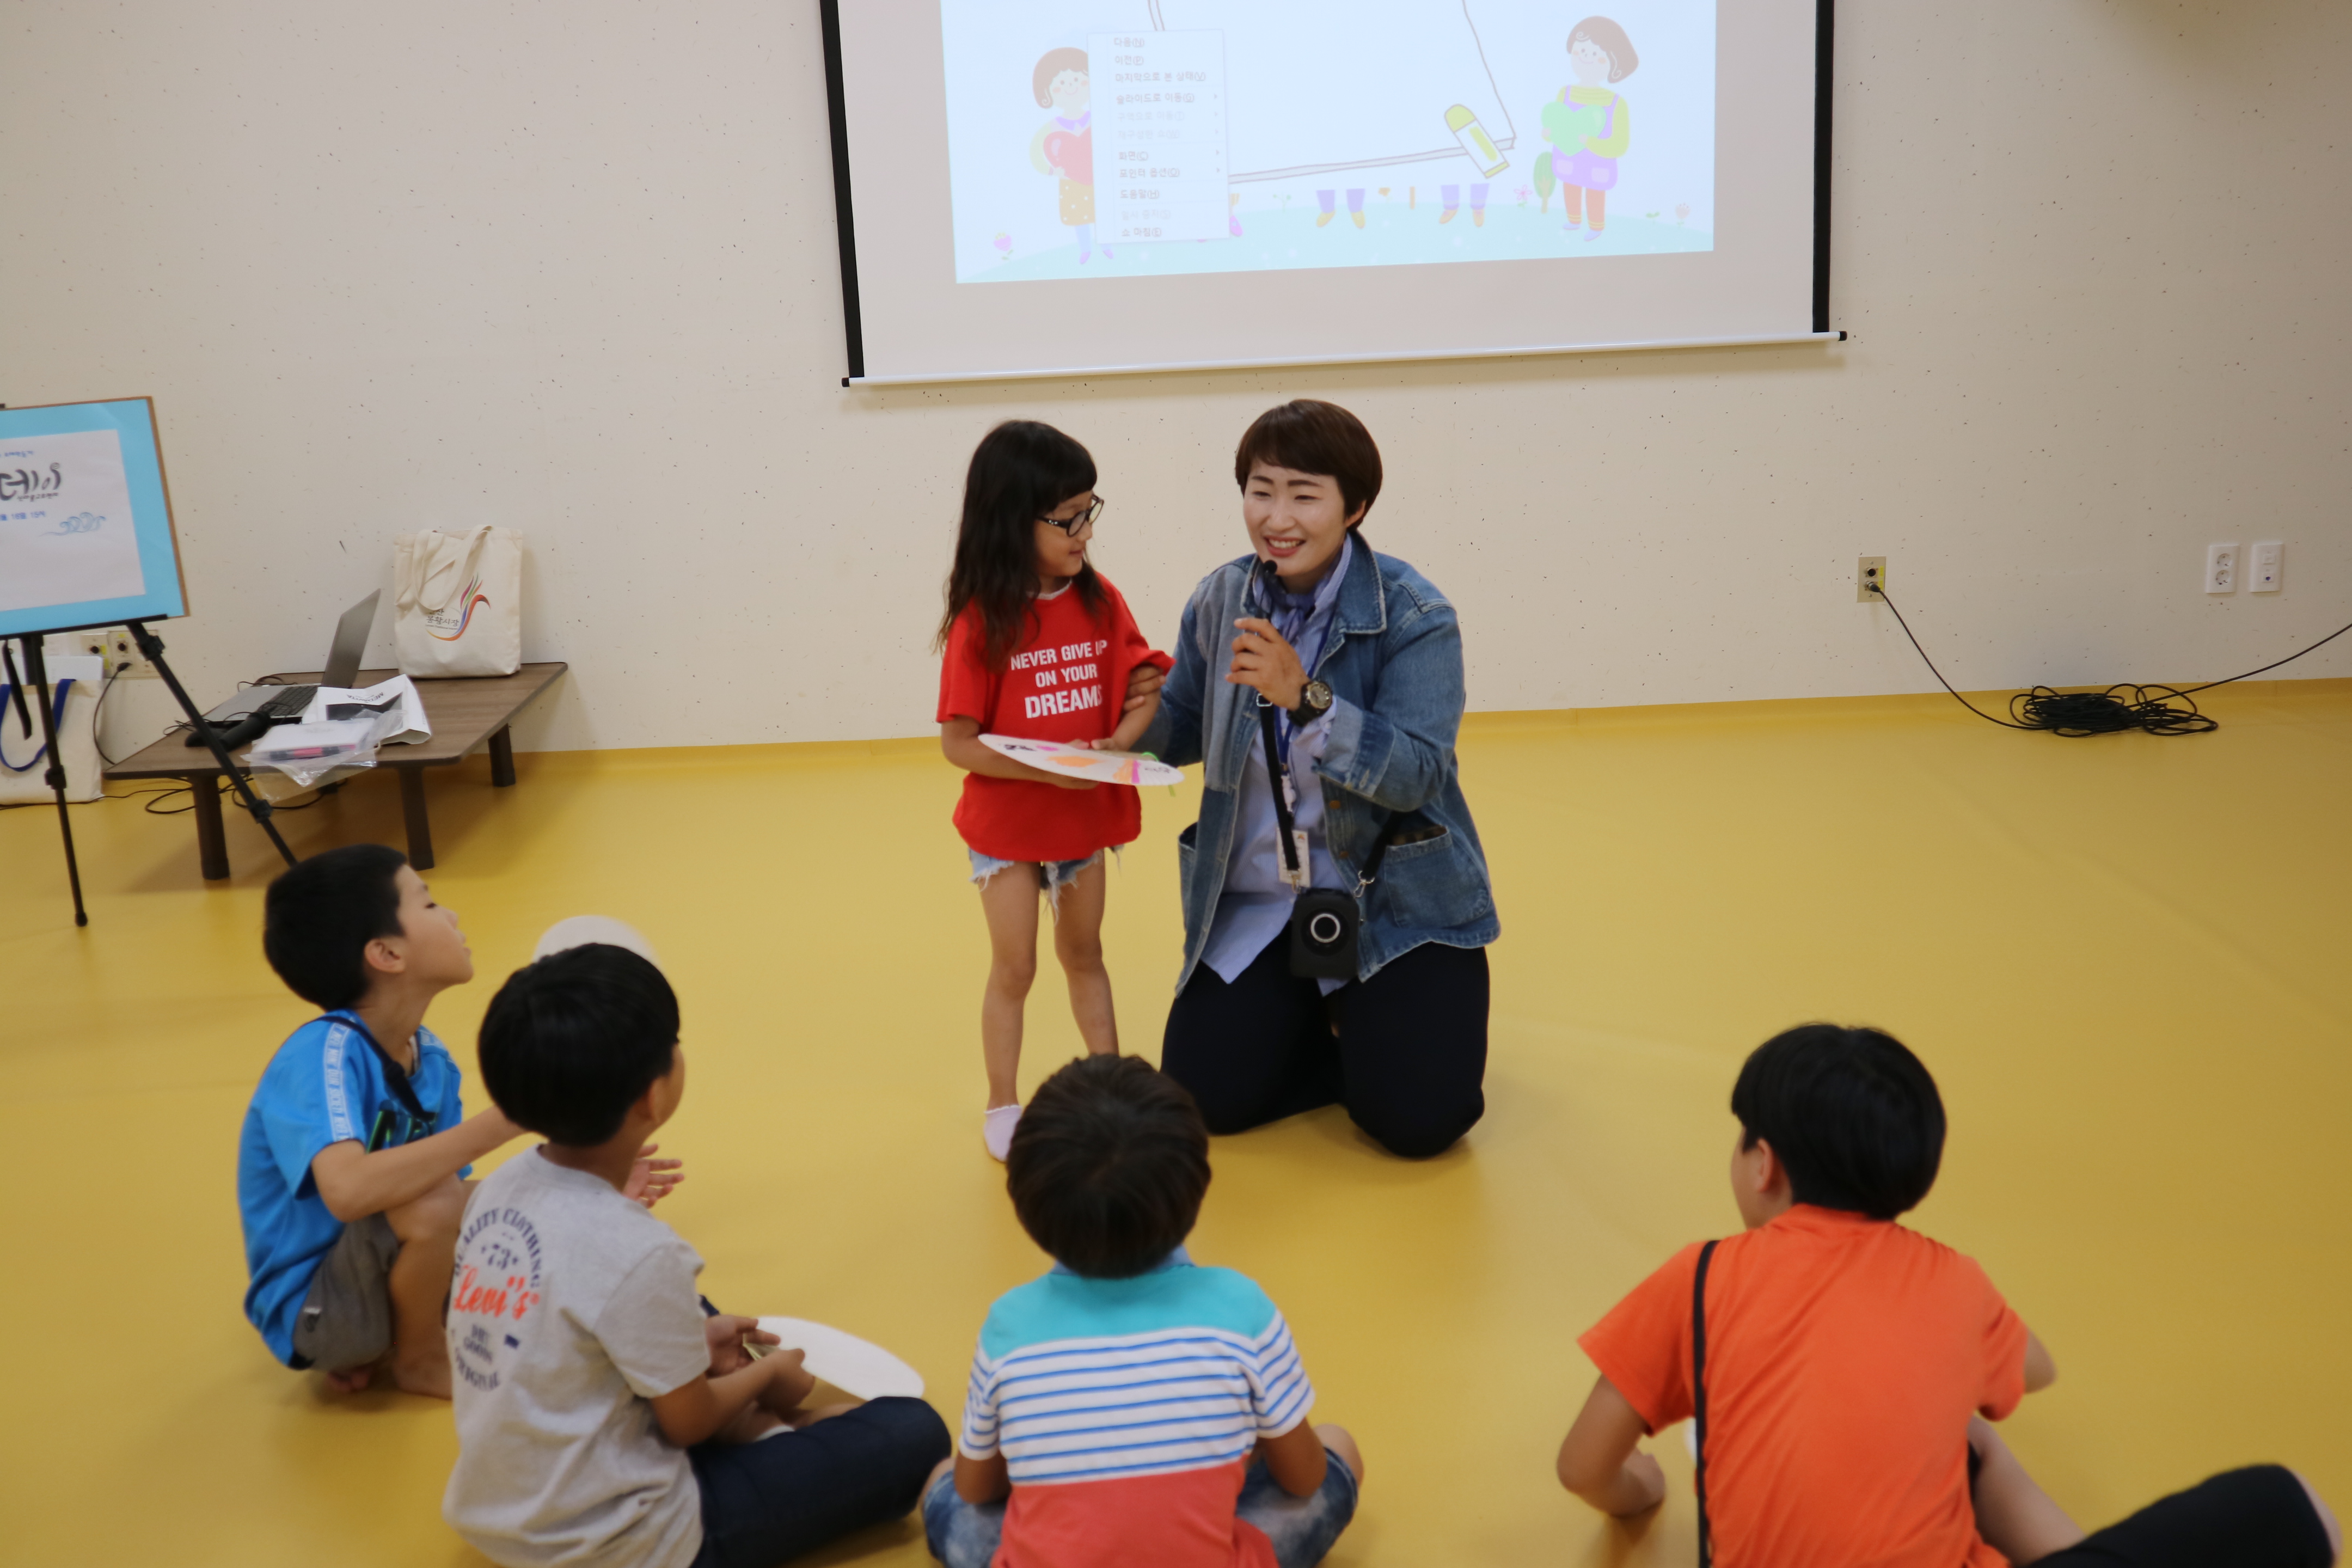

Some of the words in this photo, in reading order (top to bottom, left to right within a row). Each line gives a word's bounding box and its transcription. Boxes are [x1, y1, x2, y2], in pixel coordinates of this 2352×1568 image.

[1113, 37, 1145, 48] 다음(N)
[1114, 55, 1144, 66] 이전(P)
[1114, 72, 1160, 83] 마지막으로
[1118, 151, 1149, 161] 화면(C)
[1119, 168, 1146, 179] 포인터
[1120, 189, 1160, 200] 도움말(H)
[426, 616, 459, 627] 봉황시장
[1010, 648, 1057, 671] NEVER
[1061, 642, 1093, 661] GIVE
[1035, 670, 1057, 688] ON
[1061, 664, 1098, 683] YOUR
[347, 691, 384, 702] MEDAVITA
